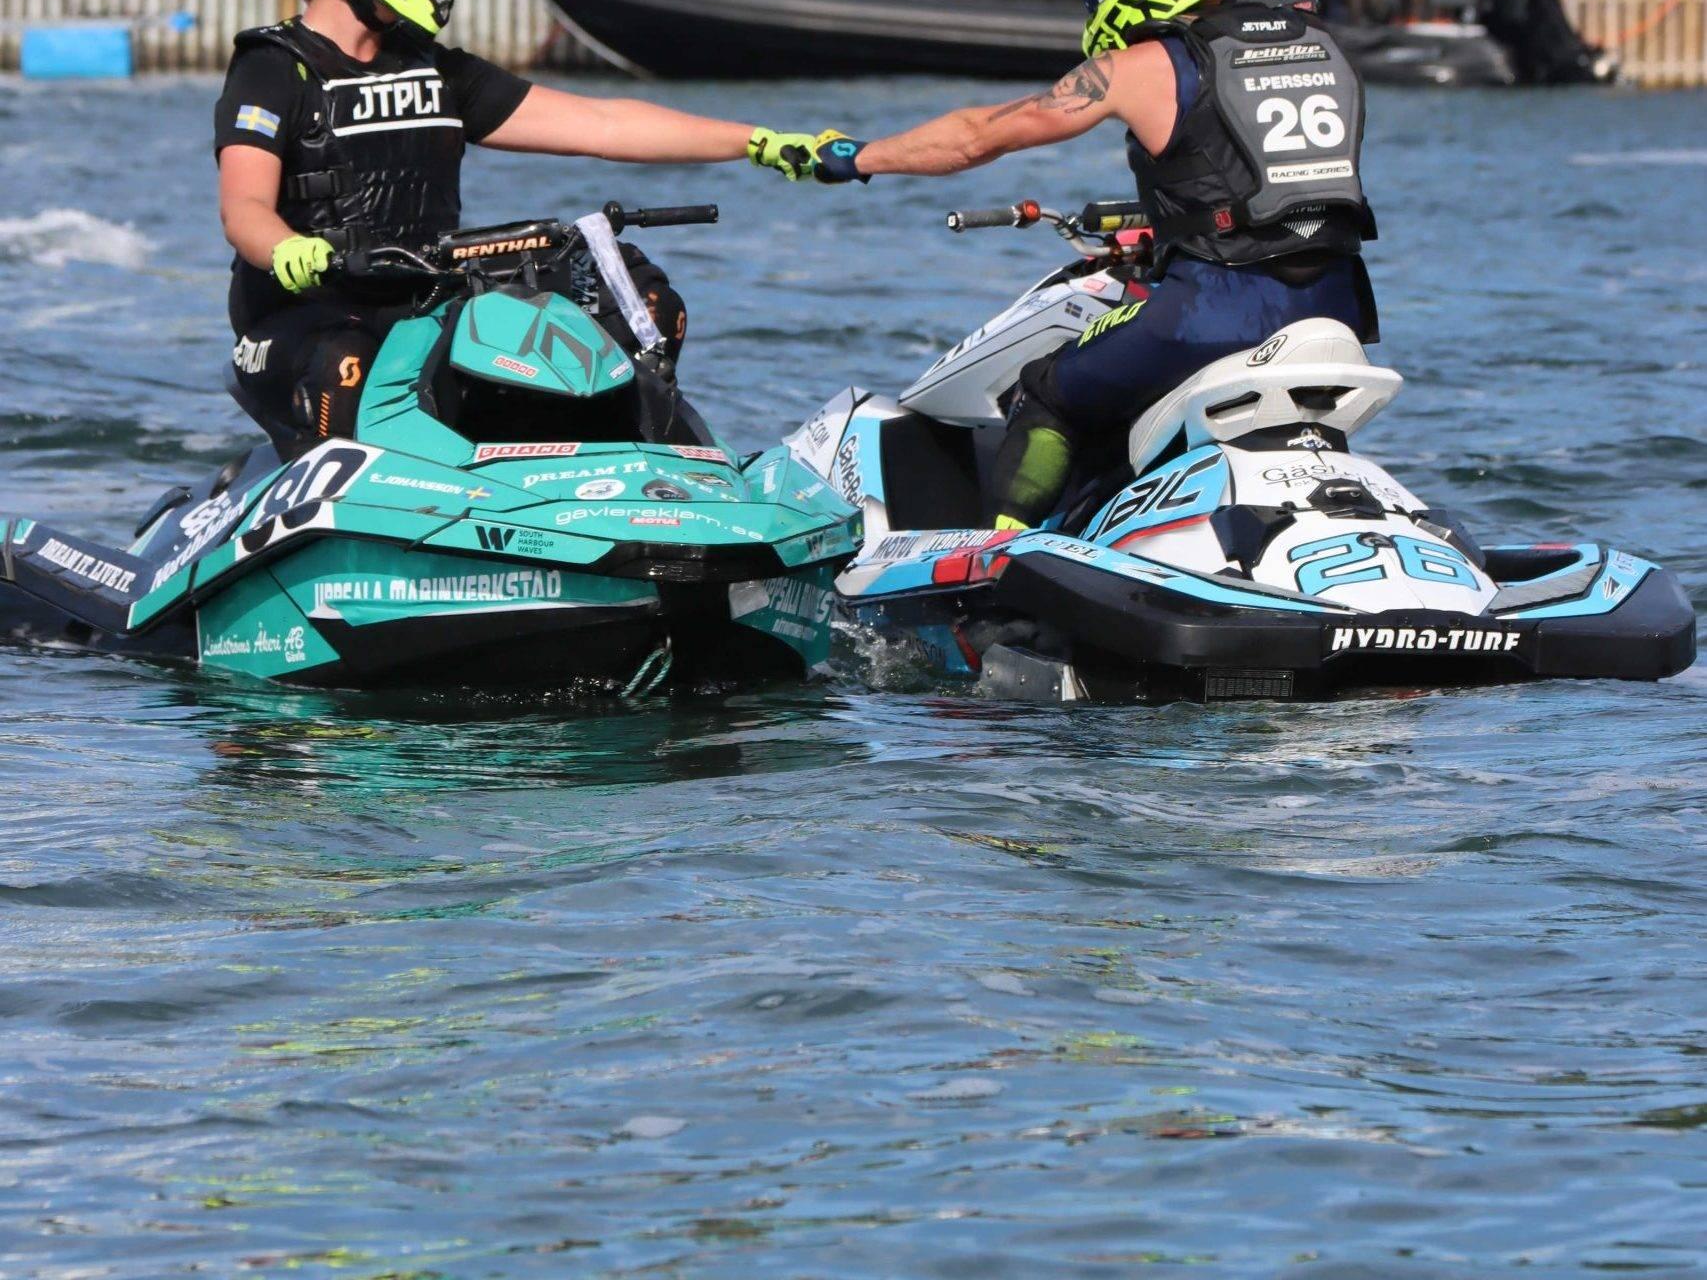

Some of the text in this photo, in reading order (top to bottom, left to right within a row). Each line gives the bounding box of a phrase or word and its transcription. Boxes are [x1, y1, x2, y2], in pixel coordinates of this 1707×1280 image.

[1242, 20, 1287, 32] JETPILOT
[1244, 72, 1336, 92] E.PERSSON
[353, 81, 443, 120] JTPLT
[1256, 94, 1346, 152] 26
[1271, 166, 1350, 179] RACING SERIES
[453, 235, 552, 260] RENTHAL
[523, 465, 617, 489] DREAM
[622, 461, 649, 474] IT
[241, 448, 367, 553] 80
[518, 539, 554, 548] HARBOUR
[518, 546, 542, 554] WAVES
[1287, 532, 1481, 596] 26
[284, 626, 304, 651] AB
[1332, 627, 1521, 652] HYDRO-TURF
